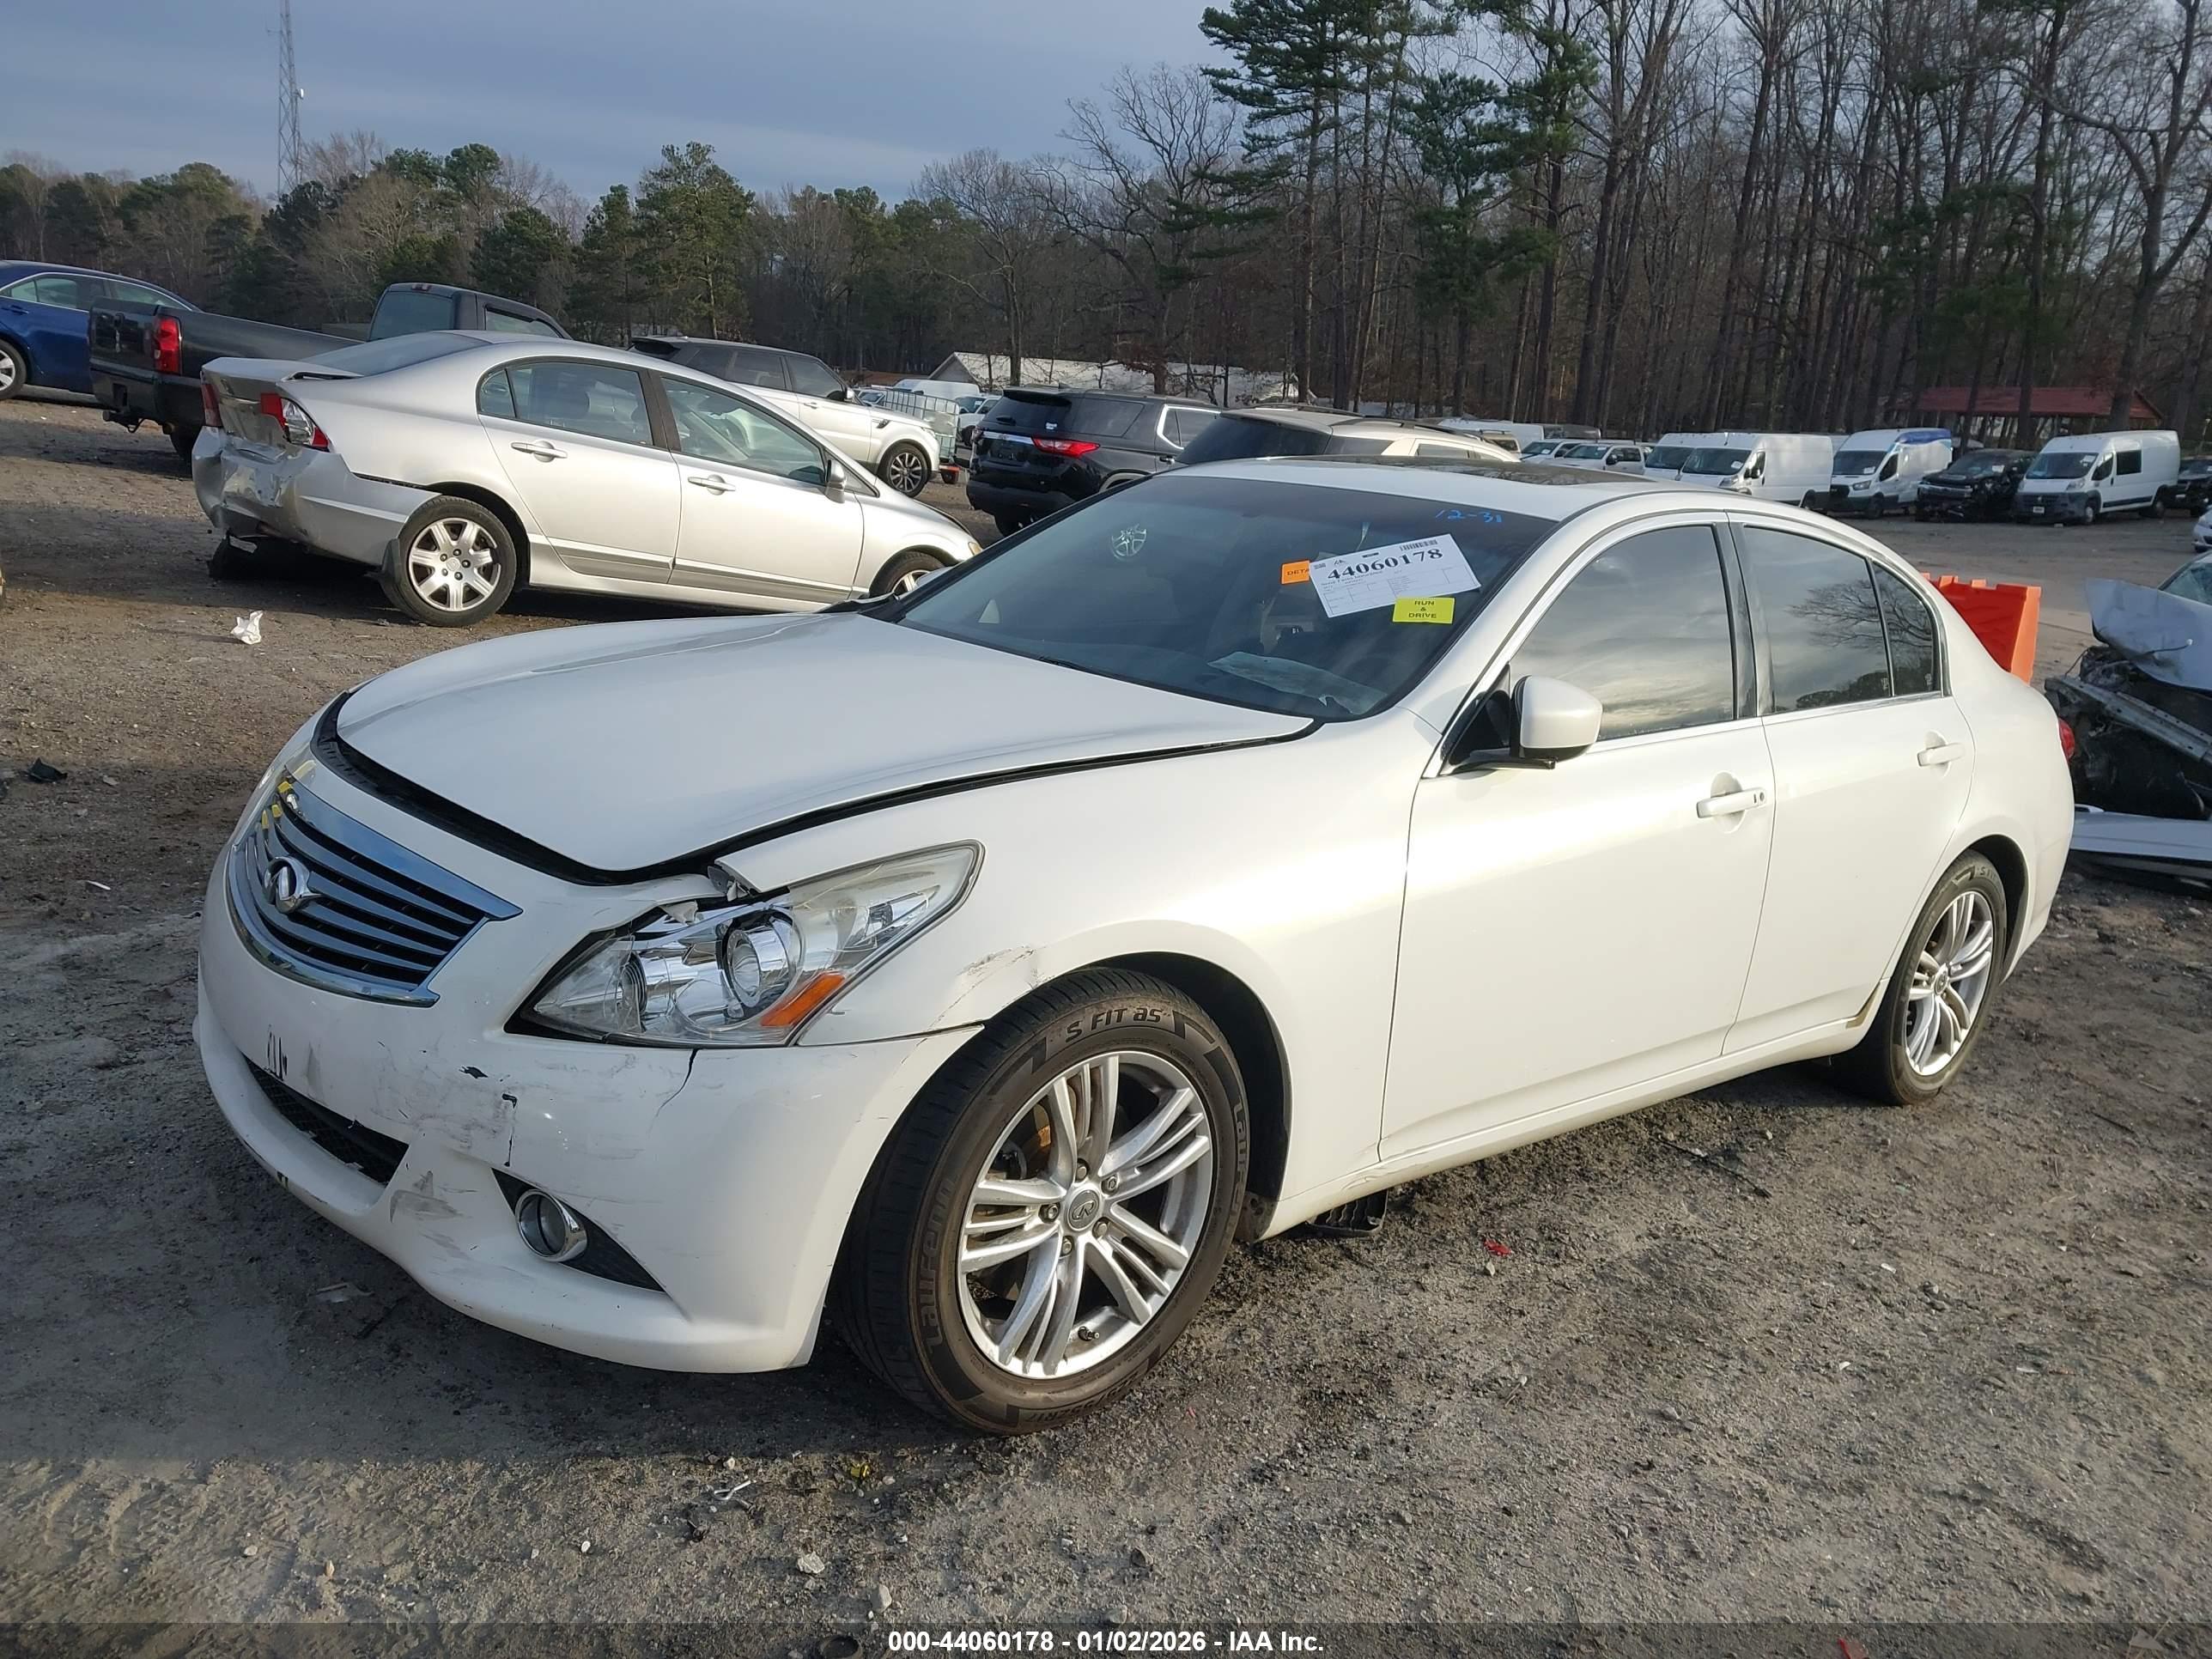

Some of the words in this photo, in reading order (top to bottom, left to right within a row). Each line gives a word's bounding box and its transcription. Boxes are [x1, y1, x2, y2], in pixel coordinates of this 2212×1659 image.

[1435, 509, 1503, 523] 12-31
[1328, 549, 1443, 579] 44060178
[1065, 1019, 1084, 1042] S
[1091, 1007, 1128, 1031] FIT
